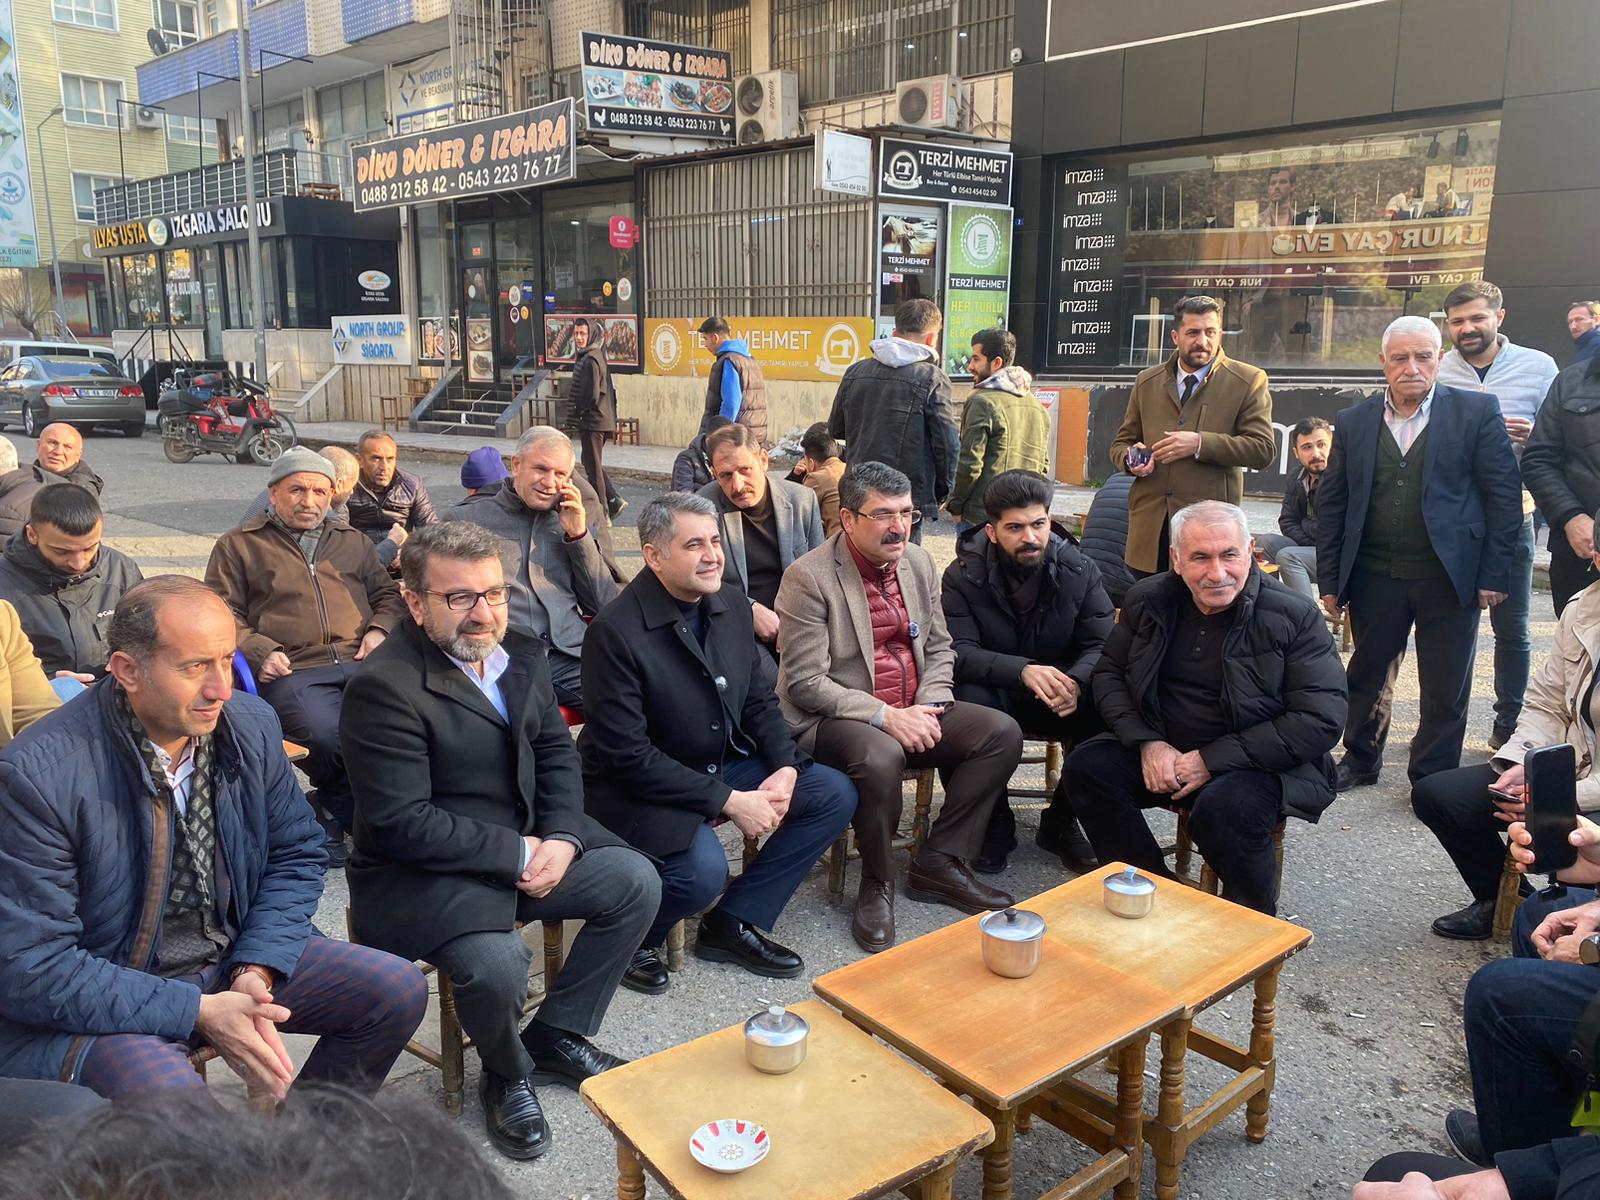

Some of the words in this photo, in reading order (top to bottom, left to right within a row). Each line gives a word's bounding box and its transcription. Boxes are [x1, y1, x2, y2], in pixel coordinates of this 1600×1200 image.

[589, 38, 624, 67] DİKO
[626, 43, 671, 73] DÖNER
[673, 52, 683, 73] &
[685, 54, 727, 79] IZGARA
[419, 70, 443, 85] NORTH
[610, 112, 628, 125] 0488
[629, 113, 643, 126] 212
[643, 114, 652, 126] 58
[653, 115, 663, 127] 42
[668, 117, 684, 129] 0543
[686, 118, 698, 130] 223
[699, 119, 707, 130] 76
[708, 120, 716, 131] 77
[357, 148, 398, 184] DİKO
[402, 138, 465, 175] DÖNER
[469, 133, 485, 164] &
[491, 115, 566, 161] IZGARA
[918, 150, 953, 169] TERZİ
[955, 154, 1008, 174] MEHMET
[361, 184, 388, 205] 0488
[390, 181, 411, 201] 212
[414, 178, 428, 197] 58
[431, 175, 448, 194] 42
[458, 168, 490, 190] 0543
[493, 163, 518, 185] 223
[523, 159, 539, 180] 76
[545, 154, 560, 176] 77
[932, 169, 943, 177] Her
[943, 170, 956, 179] Türlü
[956, 171, 971, 181] Elbise
[1064, 169, 1094, 184] imza
[958, 186, 972, 195] 0543
[972, 187, 982, 196] 454
[982, 188, 989, 197] 02
[990, 189, 997, 198] 50
[1077, 191, 1106, 206] imza
[1062, 214, 1091, 229] imza
[119, 221, 148, 246] USTA
[1075, 235, 1104, 250] imza
[888, 255, 905, 264] TERZİ
[905, 257, 931, 266] MEHMET
[1061, 257, 1089, 272] imza
[950, 277, 974, 288] TERZİ
[974, 280, 1007, 289] MEHMET
[1073, 278, 1102, 293] imza
[1059, 298, 1087, 313] imza
[349, 321, 375, 337] NORTH
[376, 320, 405, 337] GROUP
[1071, 320, 1100, 335] imza
[735, 329, 812, 350] MEHMET
[361, 340, 394, 359] SİGORTA
[1057, 341, 1085, 355] imza
